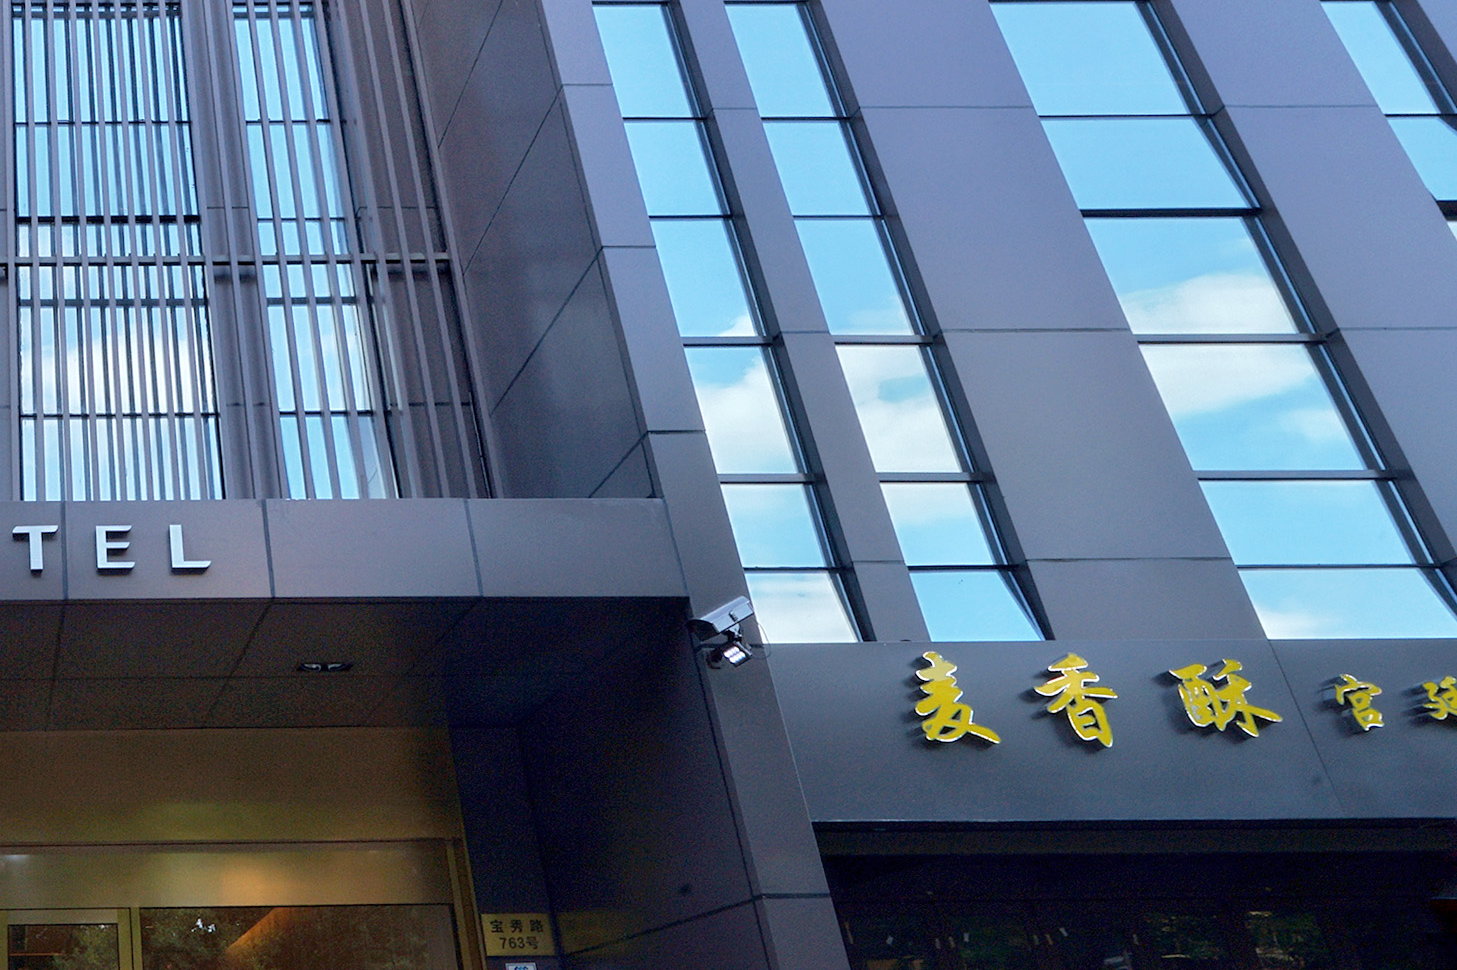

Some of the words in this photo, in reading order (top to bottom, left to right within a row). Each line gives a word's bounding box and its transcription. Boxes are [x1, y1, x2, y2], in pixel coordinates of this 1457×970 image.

[915, 650, 1283, 749] 麦香酥
[489, 919, 544, 933] 宝秀路
[499, 936, 538, 949] 763号
